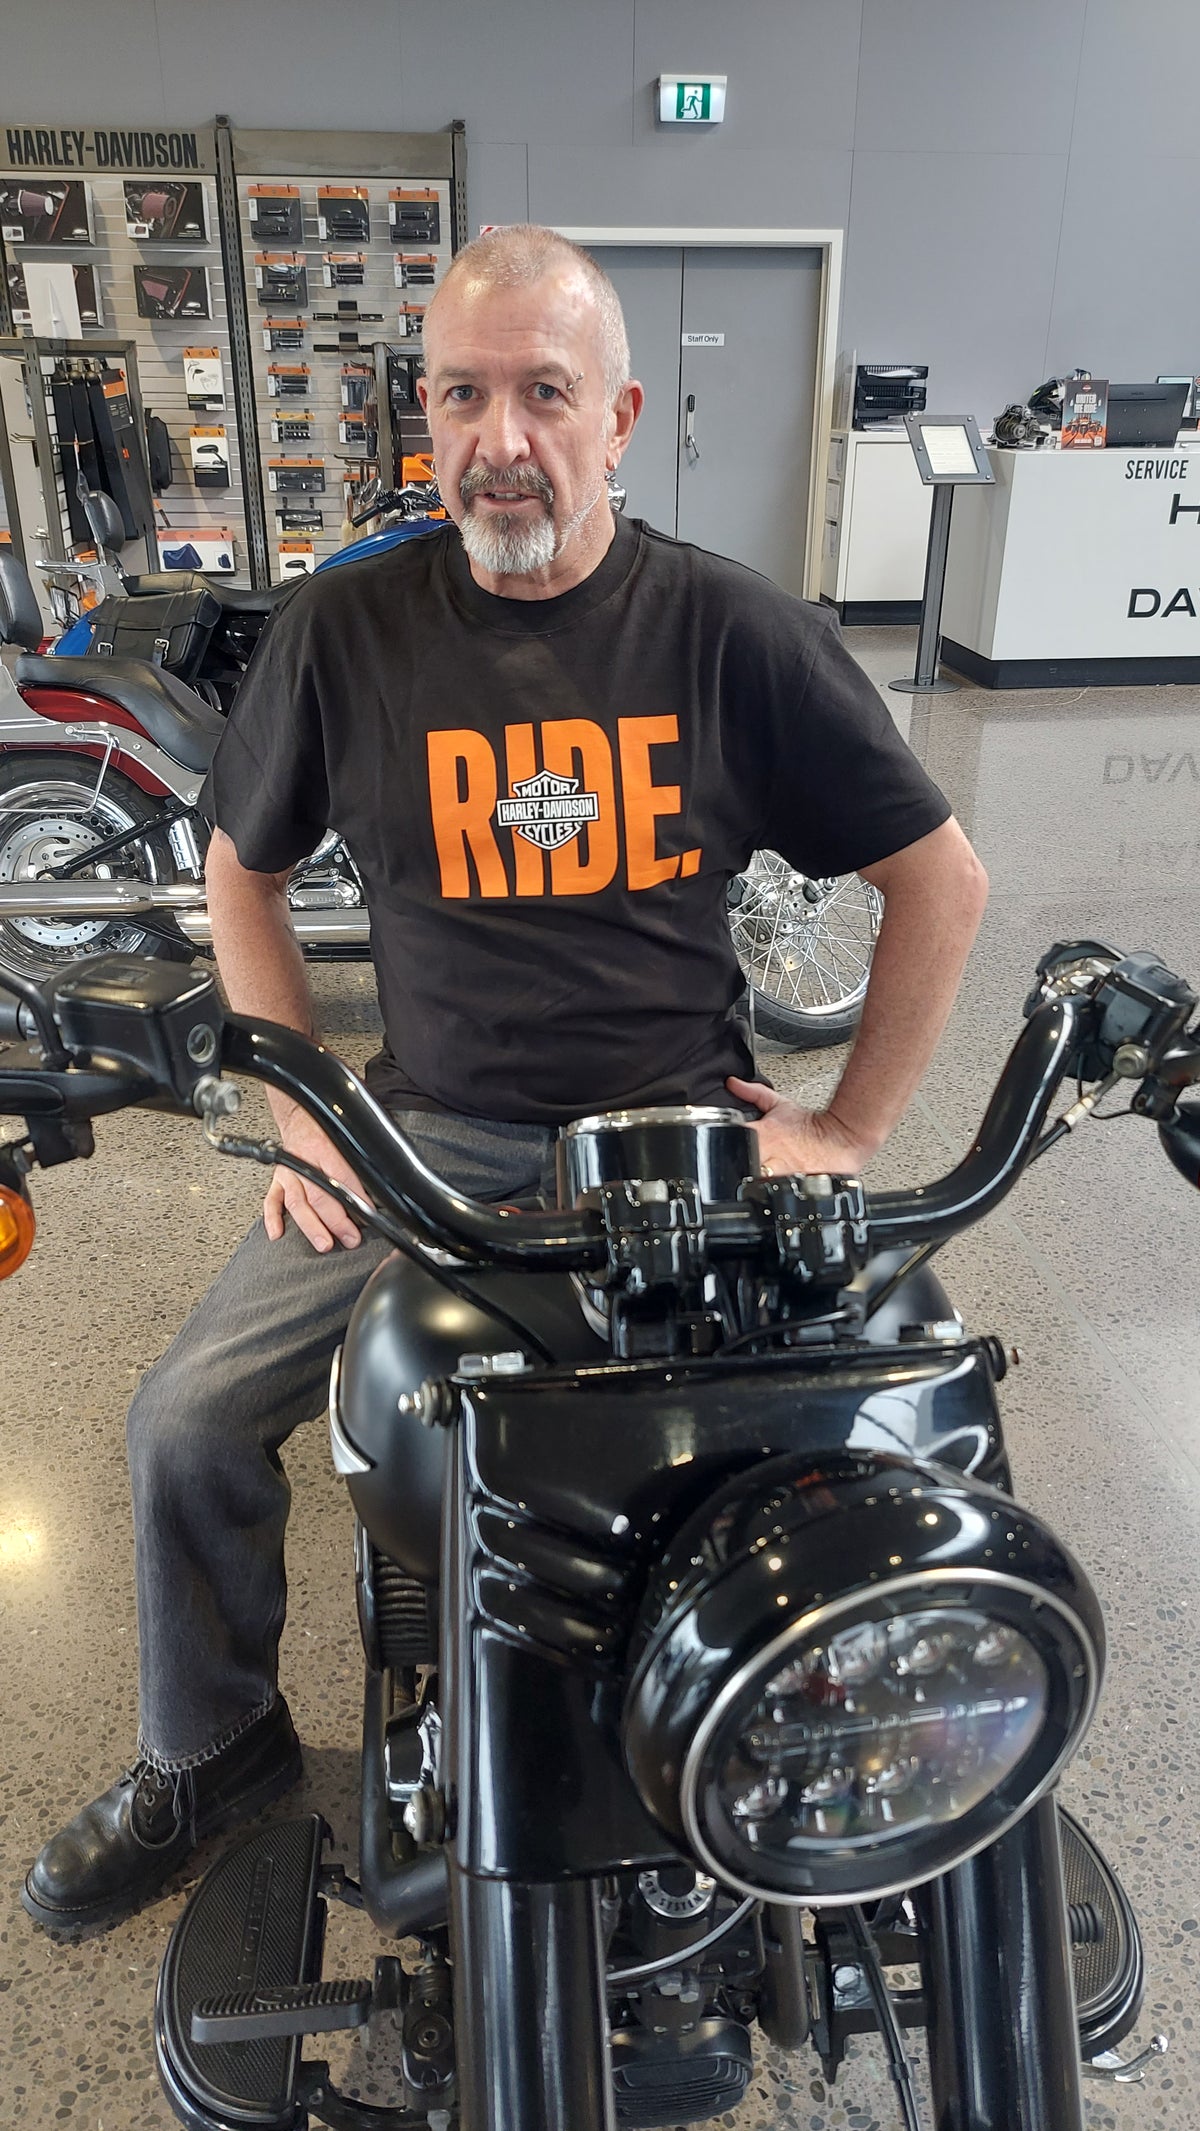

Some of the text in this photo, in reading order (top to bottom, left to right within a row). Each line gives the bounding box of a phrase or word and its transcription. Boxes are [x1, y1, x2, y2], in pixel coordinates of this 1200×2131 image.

[6, 129, 199, 168] HARLEY-DAVIDSON
[704, 335, 719, 343] Only
[1125, 460, 1189, 479] SERVICE
[1127, 588, 1200, 618] DA
[521, 775, 572, 797] MOTOR
[502, 798, 594, 822] HARLEY-DAVIDSON
[525, 823, 575, 844] CYCLES
